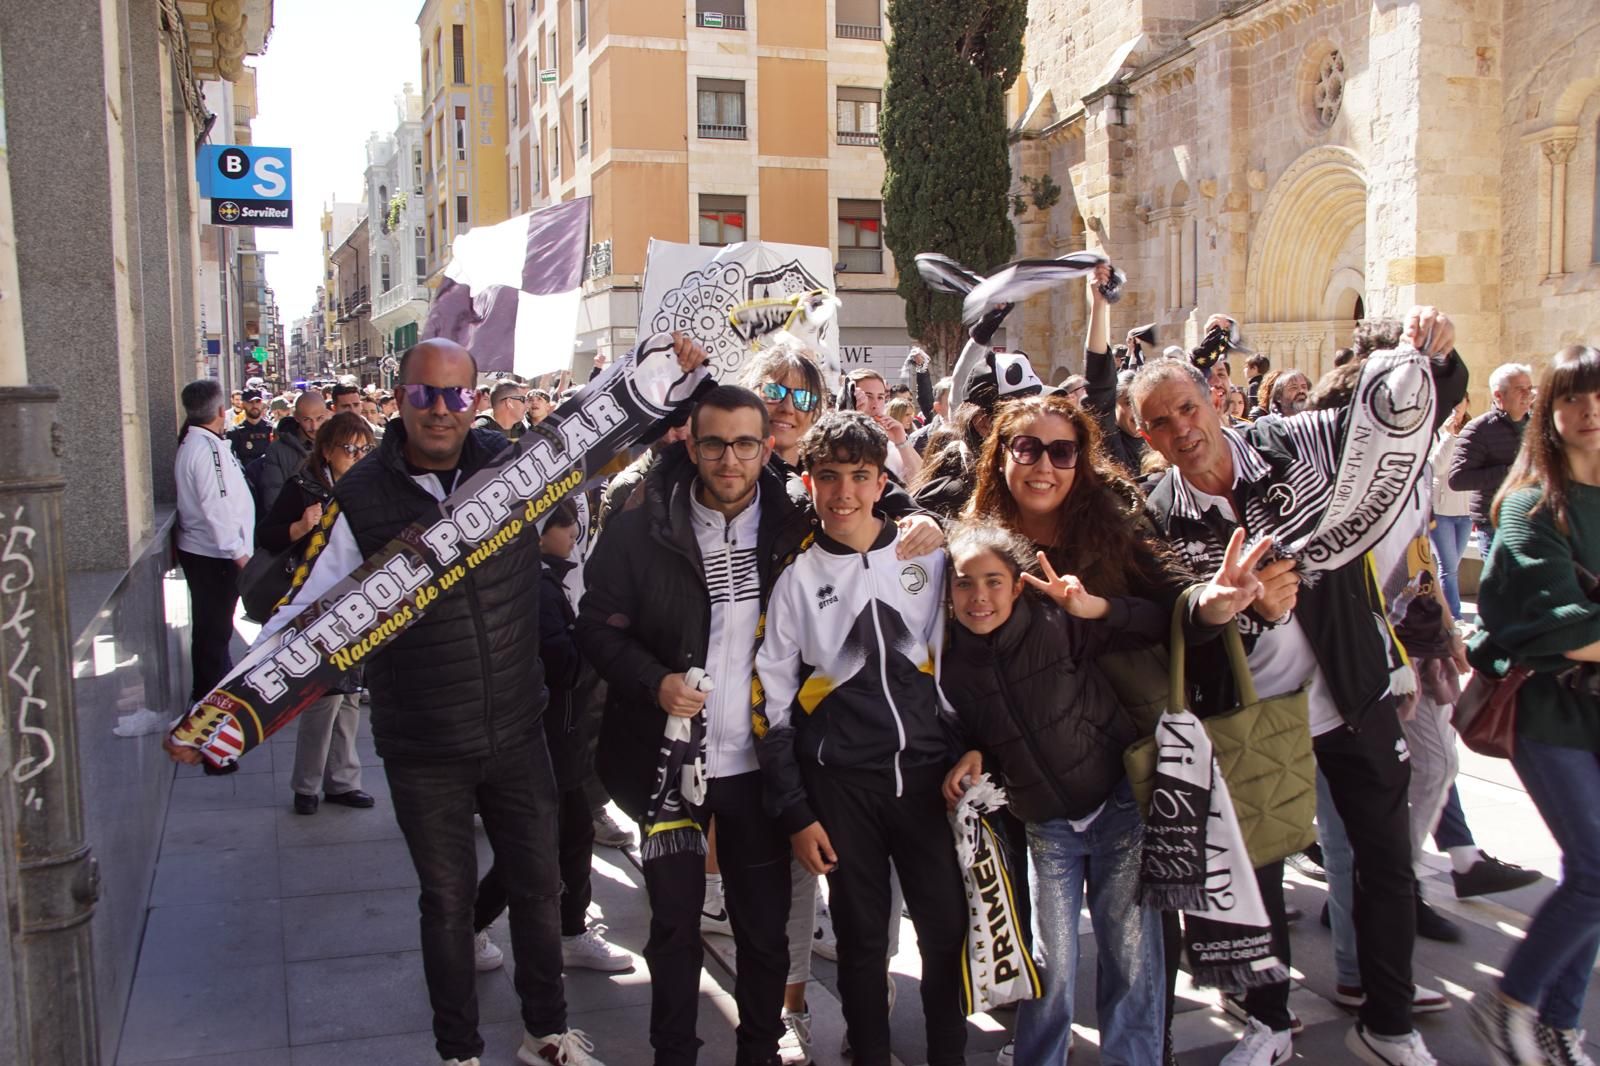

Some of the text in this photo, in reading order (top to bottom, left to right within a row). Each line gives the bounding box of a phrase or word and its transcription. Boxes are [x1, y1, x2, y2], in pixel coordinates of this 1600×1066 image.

[226, 155, 287, 197] B S
[241, 206, 289, 218] ServiRed
[244, 391, 629, 703] FÚTBOL POPULAR
[1309, 451, 1417, 564] UNIONISTAS
[329, 469, 583, 671] Nacemos de un mismo destino
